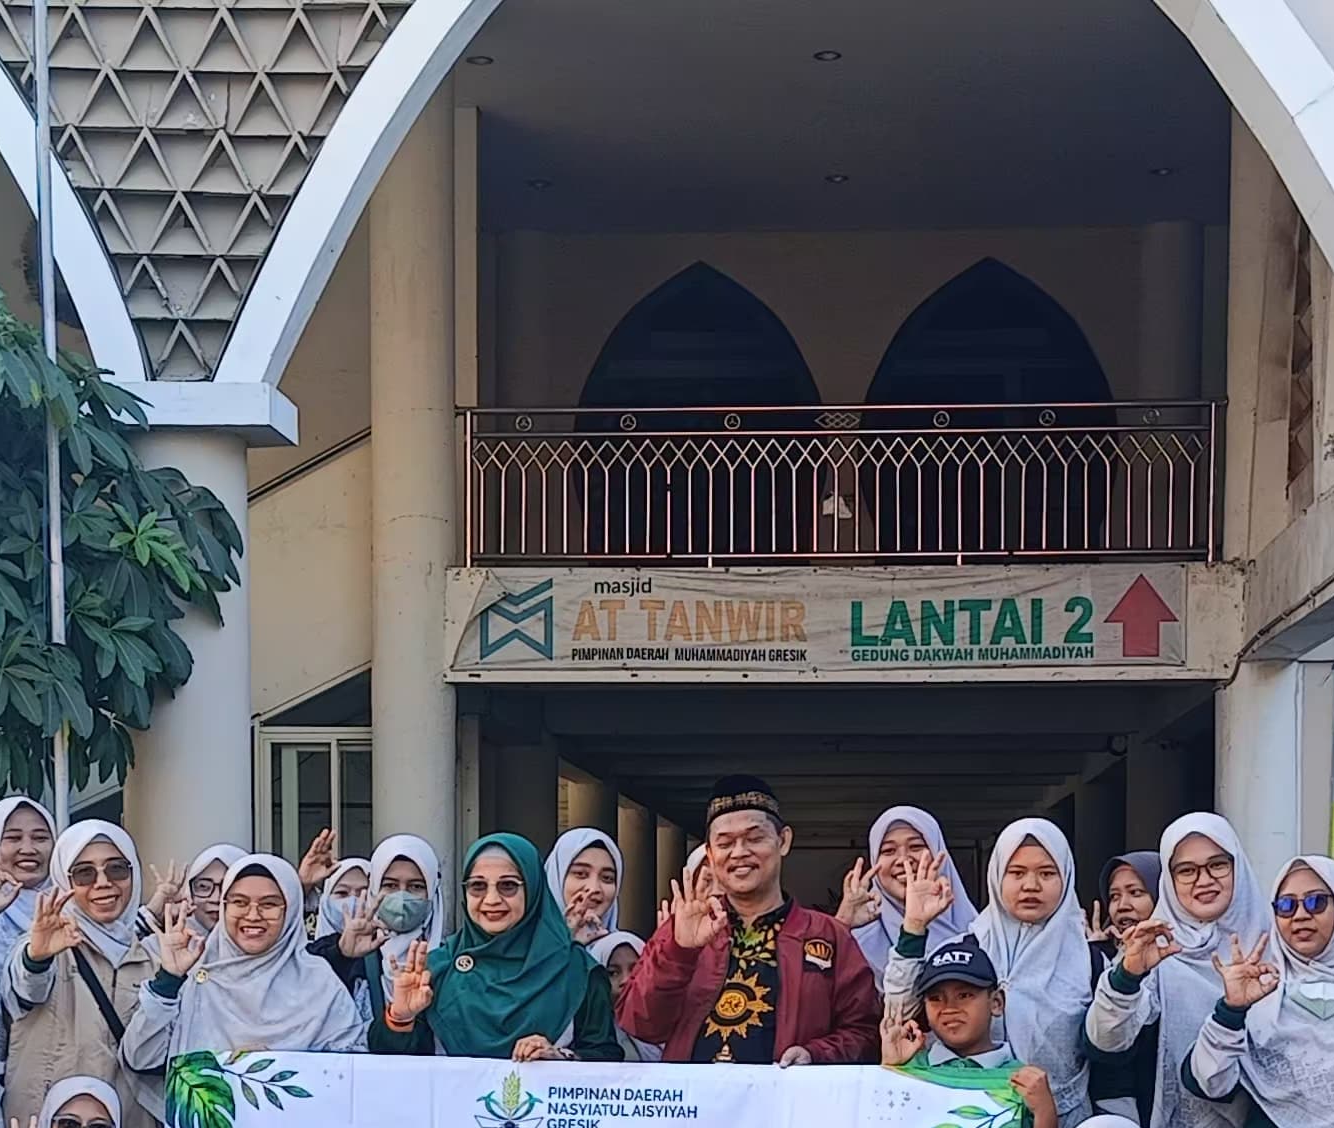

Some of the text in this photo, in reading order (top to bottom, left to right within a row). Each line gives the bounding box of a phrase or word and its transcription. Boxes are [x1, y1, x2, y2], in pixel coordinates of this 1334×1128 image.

[594, 578, 652, 597] masjid
[572, 600, 808, 642] AT TANWIR
[851, 596, 1094, 647] LANTAI 2
[571, 648, 807, 662] PIMPINAN DAERAH MUHAMMADIYAH GRESIK
[851, 646, 1095, 662] GEDUNG DAKWAH MUHAMMADIYAH
[548, 1086, 683, 1102] PIMPINAN DAERAH
[548, 1102, 698, 1119] NASYIATUL AISYIYAH
